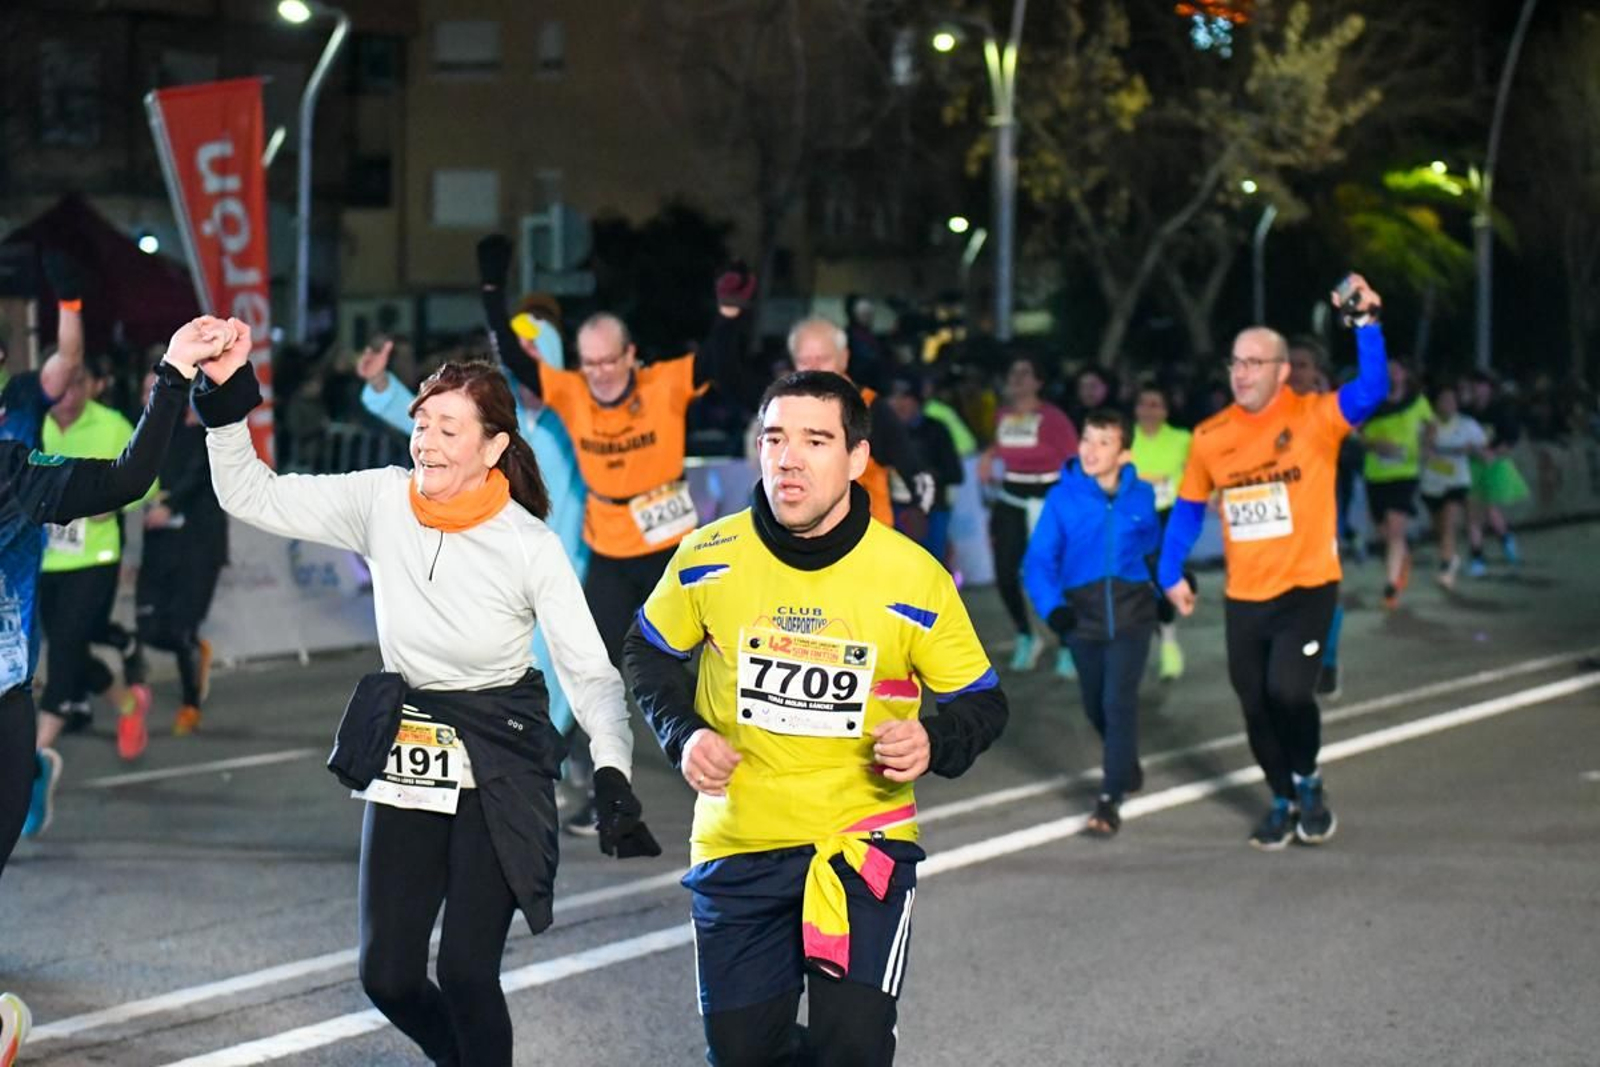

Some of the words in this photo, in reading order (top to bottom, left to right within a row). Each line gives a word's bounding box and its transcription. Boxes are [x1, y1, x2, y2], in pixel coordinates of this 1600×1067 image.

[777, 606, 822, 616] CLUB
[768, 635, 792, 654] 42
[749, 656, 858, 701] 7709
[389, 745, 449, 778] 191
